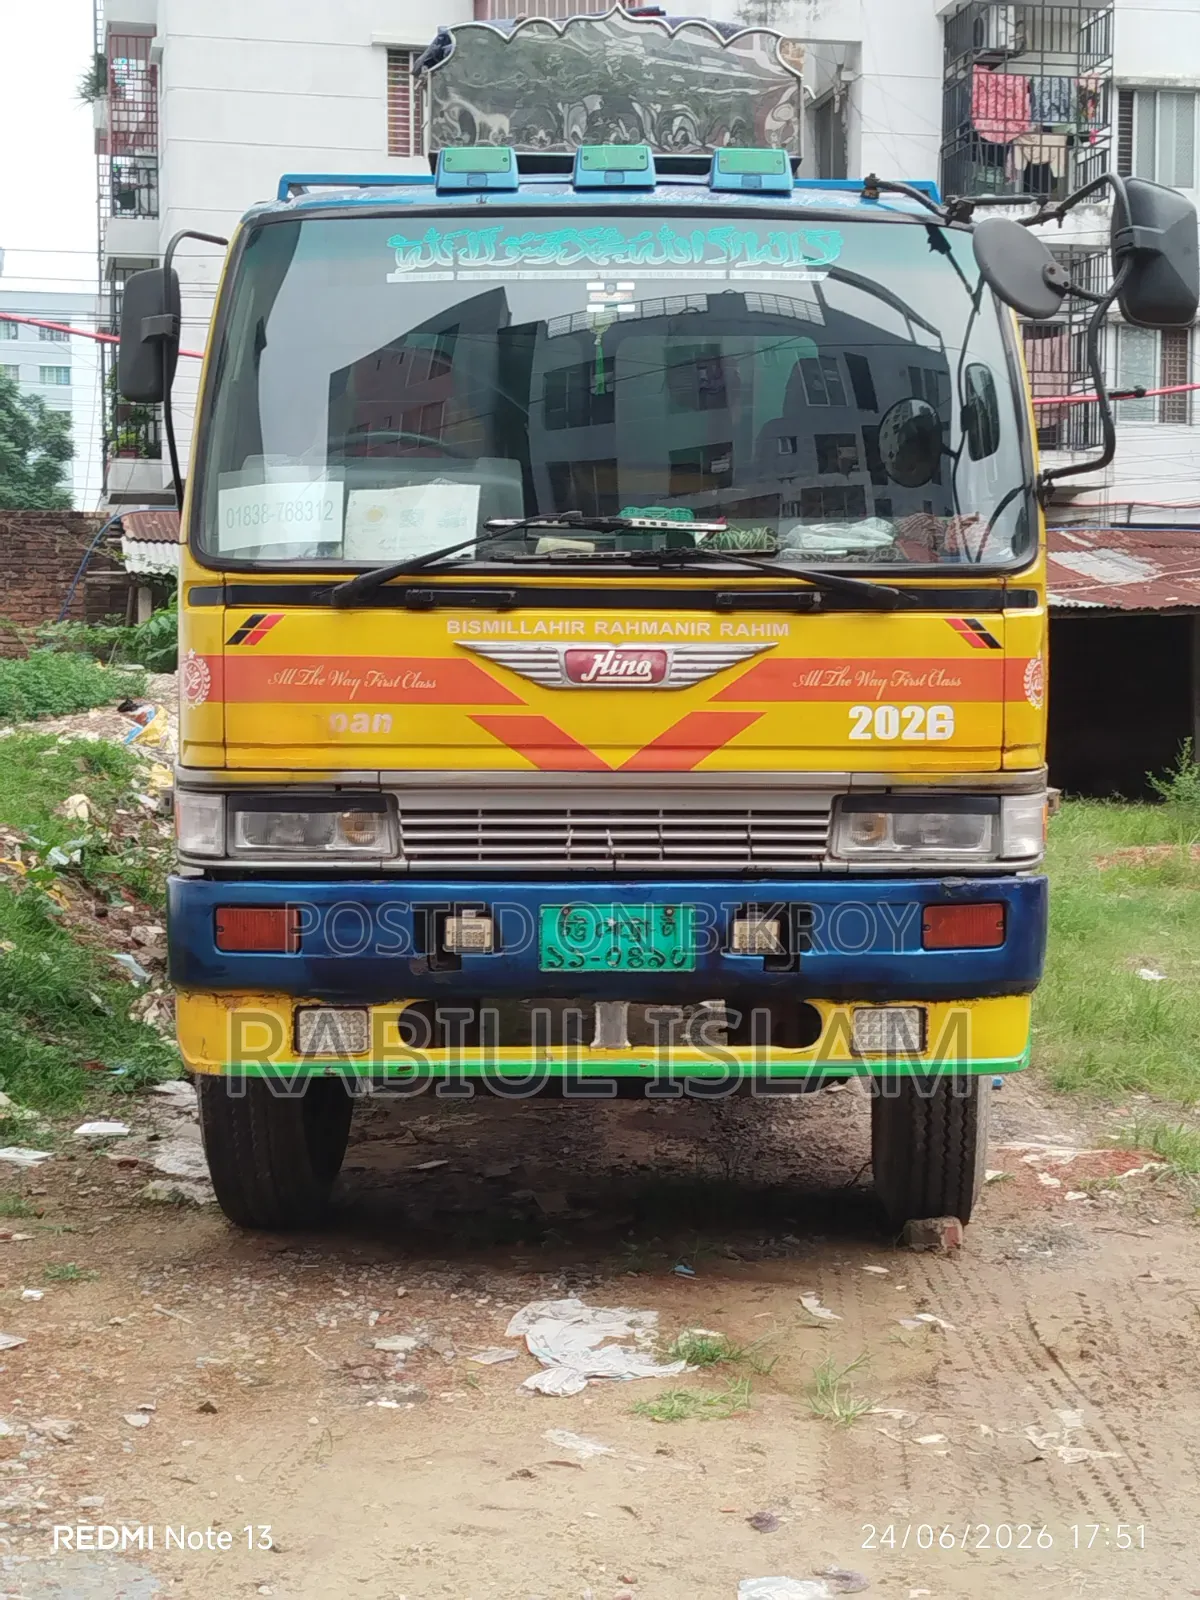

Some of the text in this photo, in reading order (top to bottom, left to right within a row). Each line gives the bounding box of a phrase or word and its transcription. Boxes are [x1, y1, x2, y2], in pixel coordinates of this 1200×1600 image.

[226, 500, 334, 529] 01838-768312
[446, 619, 790, 638] BISMILLAHIR RAHMANIR RAHIM
[267, 664, 437, 701] All The Way First Class
[580, 649, 655, 683] Hino
[792, 664, 962, 701] All The Way First Class
[847, 704, 955, 741] 2026
